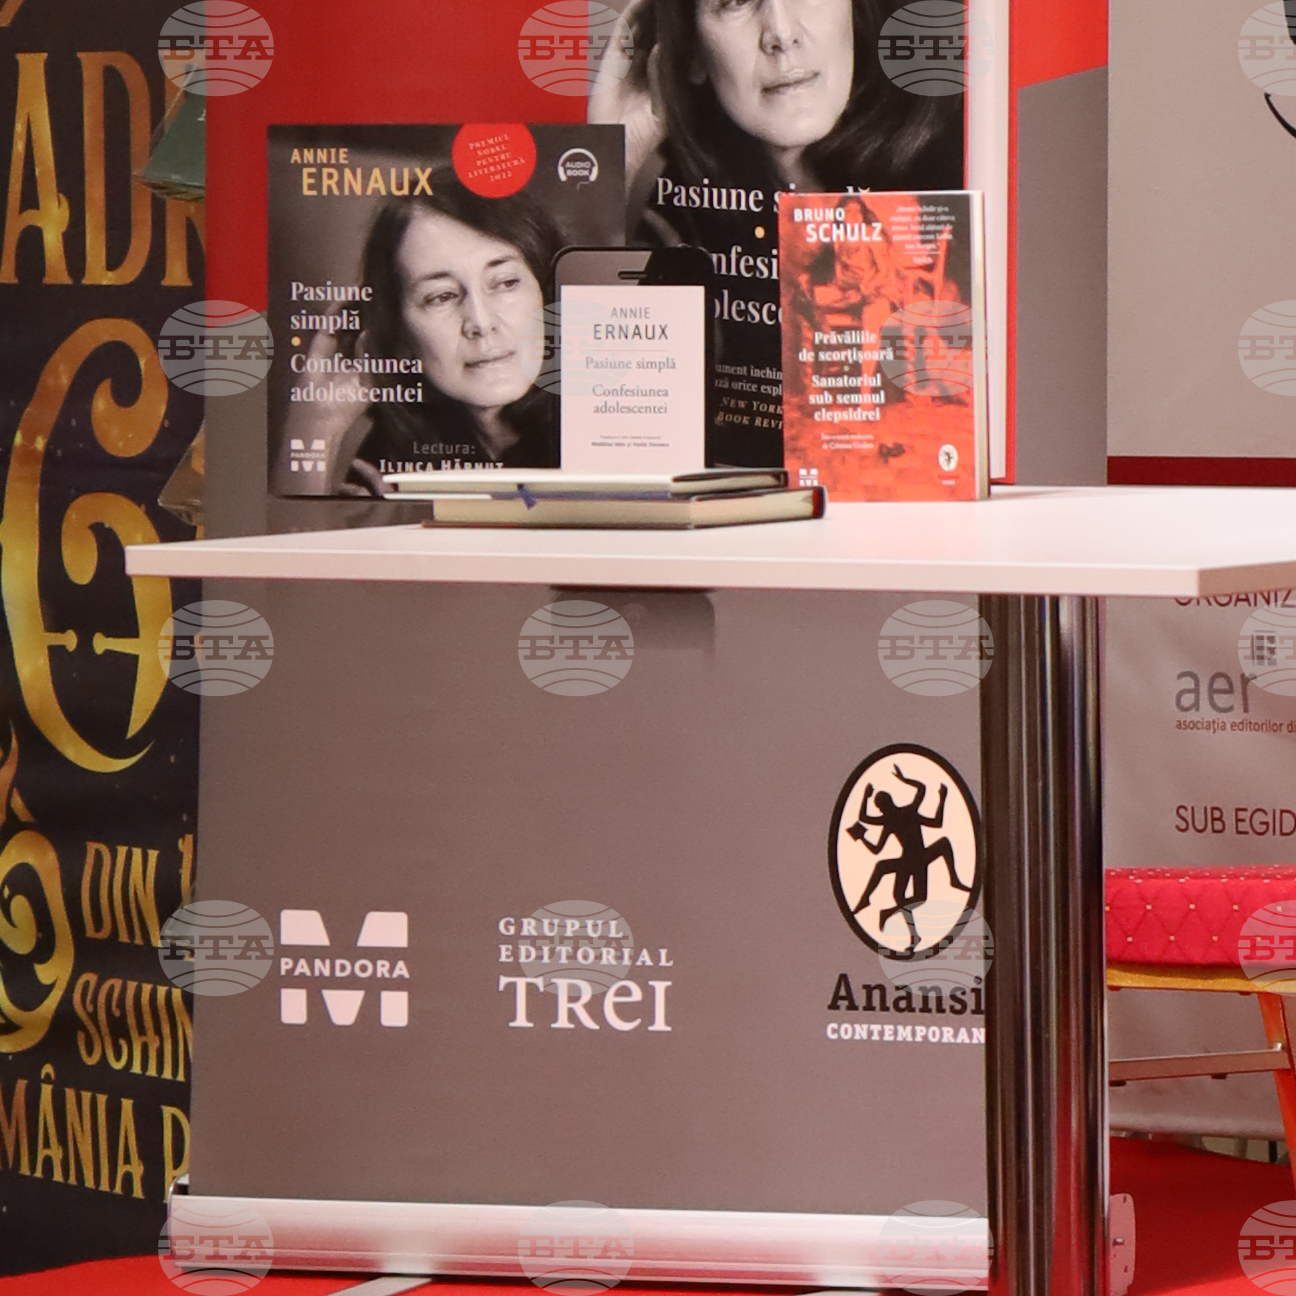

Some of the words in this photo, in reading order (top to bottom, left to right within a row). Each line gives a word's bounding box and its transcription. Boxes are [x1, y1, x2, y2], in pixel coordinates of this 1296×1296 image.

[290, 148, 349, 165] ANNIE
[565, 161, 591, 169] AUDIO
[301, 167, 434, 196] ERNAUX
[656, 177, 764, 213] Pasiune
[793, 207, 846, 222] BRUNO
[806, 222, 882, 243] SCHULZ
[290, 281, 373, 302] Pasiune
[610, 307, 651, 319] ANNIE
[290, 309, 361, 335] simplă
[593, 324, 669, 340] ERNAUX
[814, 329, 877, 345] Prăvăliile
[798, 348, 815, 362] de
[290, 353, 423, 376] Confesiunea
[585, 356, 633, 370] Pasiune
[636, 357, 676, 373] simplă
[811, 373, 882, 388] Sanatoriul
[290, 382, 423, 404] adolescentei
[592, 384, 669, 397] Confesiunea
[760, 383, 782, 396] expl
[809, 391, 833, 404] sub
[836, 390, 885, 404] semnul
[814, 407, 881, 423] clepsidrei
[413, 441, 476, 455] Lectura:
[1174, 670, 1258, 714] aer
[1230, 719, 1284, 734] editorilor
[1175, 805, 1226, 834] SUB
[80, 840, 162, 948] DIN
[498, 916, 624, 938] GRUPUL
[498, 943, 675, 967] EDITORIAL
[280, 957, 410, 979] PANDORA
[826, 972, 985, 1018] Anansi
